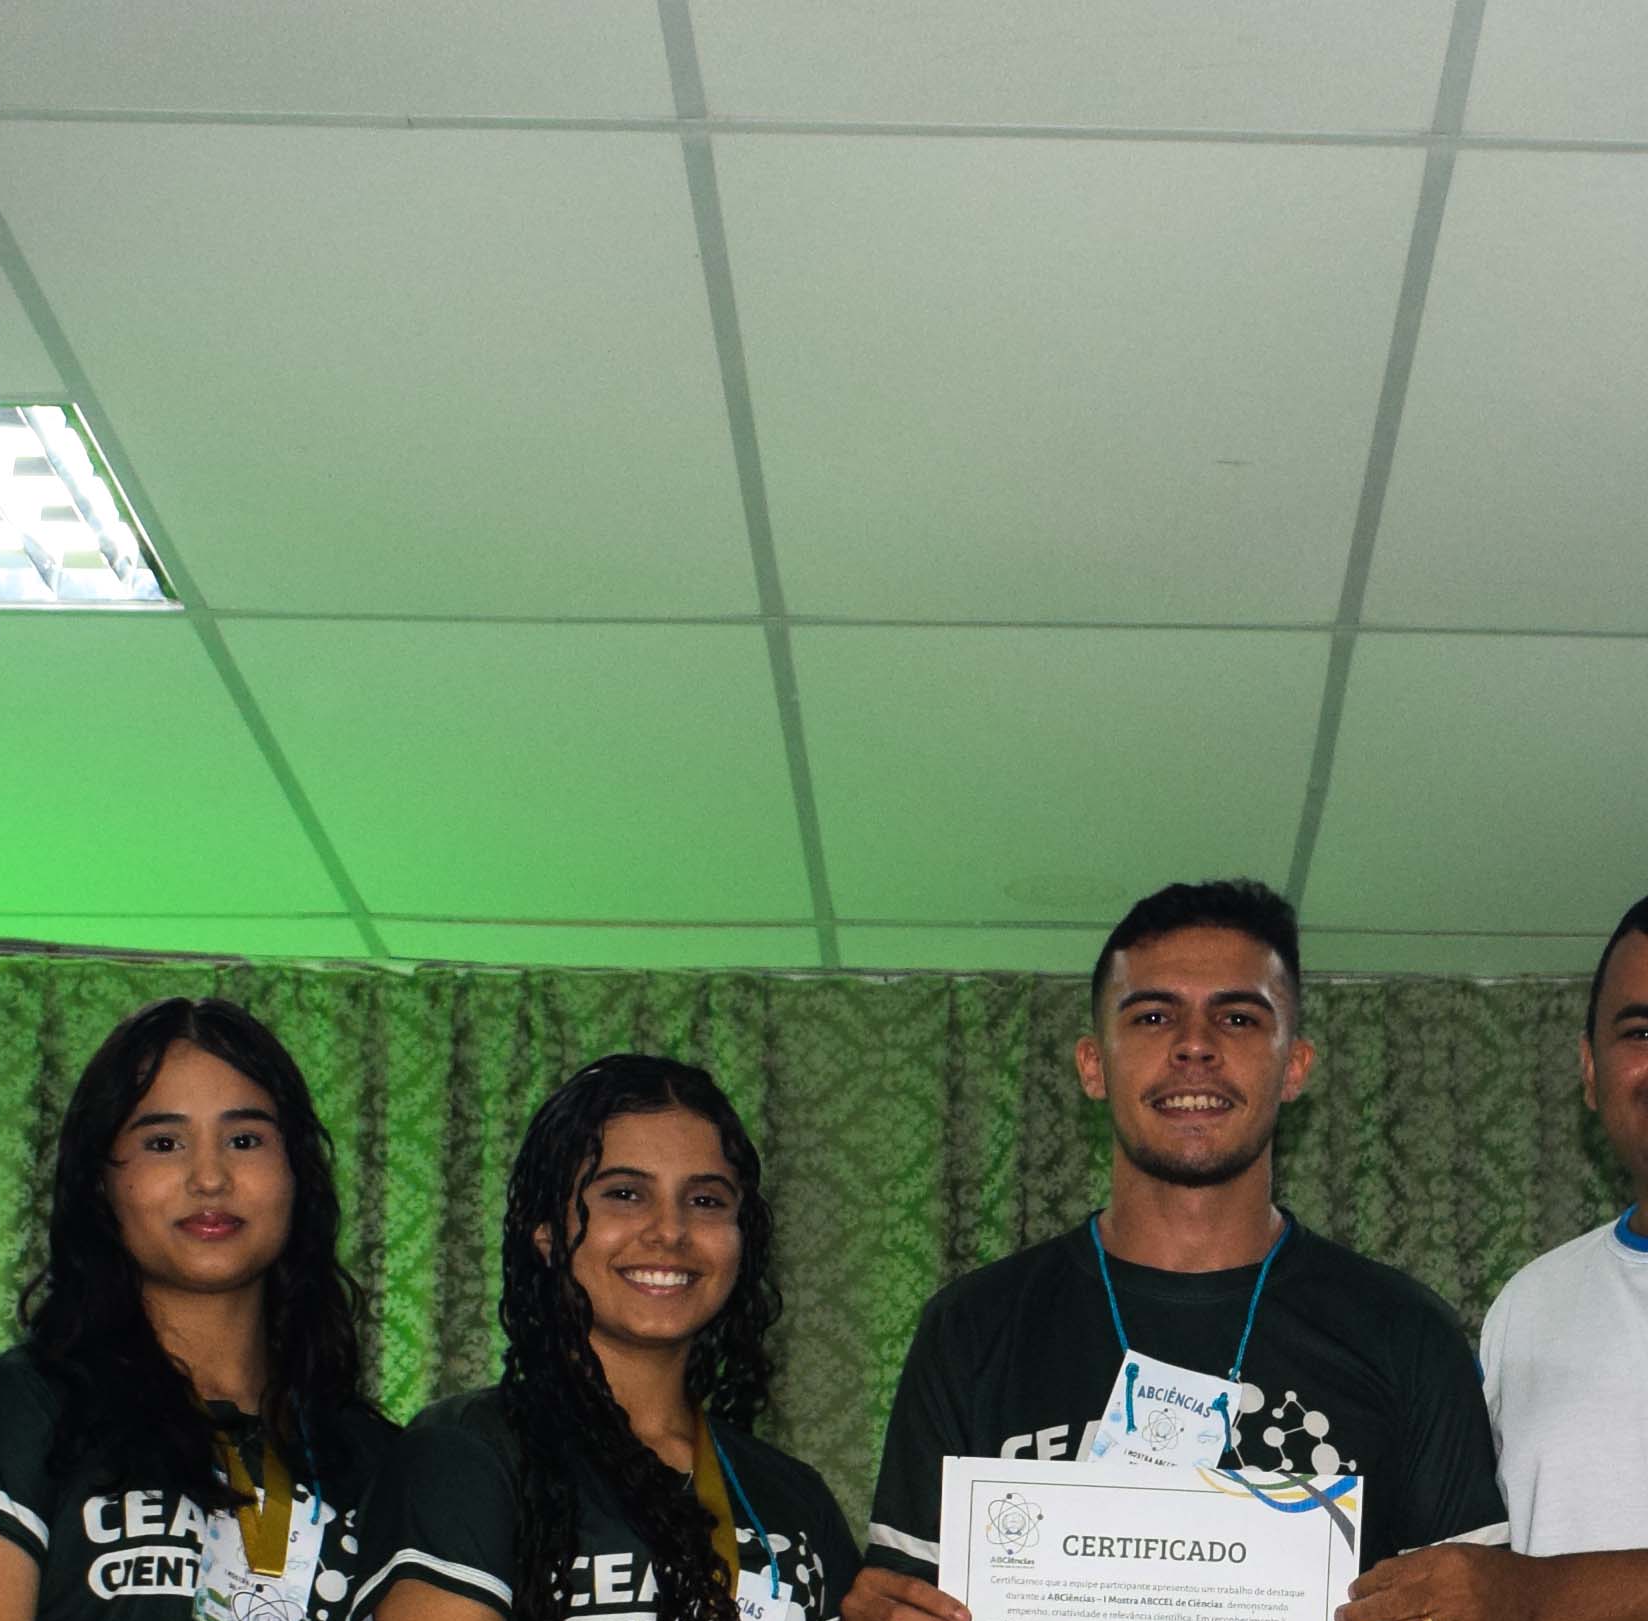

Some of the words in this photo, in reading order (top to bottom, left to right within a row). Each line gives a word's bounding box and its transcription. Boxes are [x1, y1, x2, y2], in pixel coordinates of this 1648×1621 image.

[1137, 1386, 1212, 1418] ABCIÊNCIAS
[83, 1490, 204, 1543] CEA
[1062, 1534, 1247, 1564] CERTIFICADO
[990, 1575, 1044, 1586] Certificamos
[1045, 1580, 1061, 1590] que
[1069, 1578, 1098, 1591] equipe
[1100, 1580, 1151, 1594] participante
[1152, 1582, 1198, 1596] apresentou
[1218, 1585, 1253, 1595] trabalho
[1254, 1587, 1265, 1596] de
[1266, 1587, 1305, 1600] destaque
[736, 1597, 764, 1620] CIAS
[1006, 1591, 1039, 1601] durante
[1047, 1592, 1095, 1603] ABCiências
[1108, 1595, 1138, 1605] Mostra
[1140, 1596, 1173, 1607] ABCCEL
[1176, 1598, 1186, 1607] de
[1227, 1600, 1288, 1612] demonstrando
[1052, 1608, 1101, 1619] criatividade
[1109, 1610, 1152, 1621] relevância
